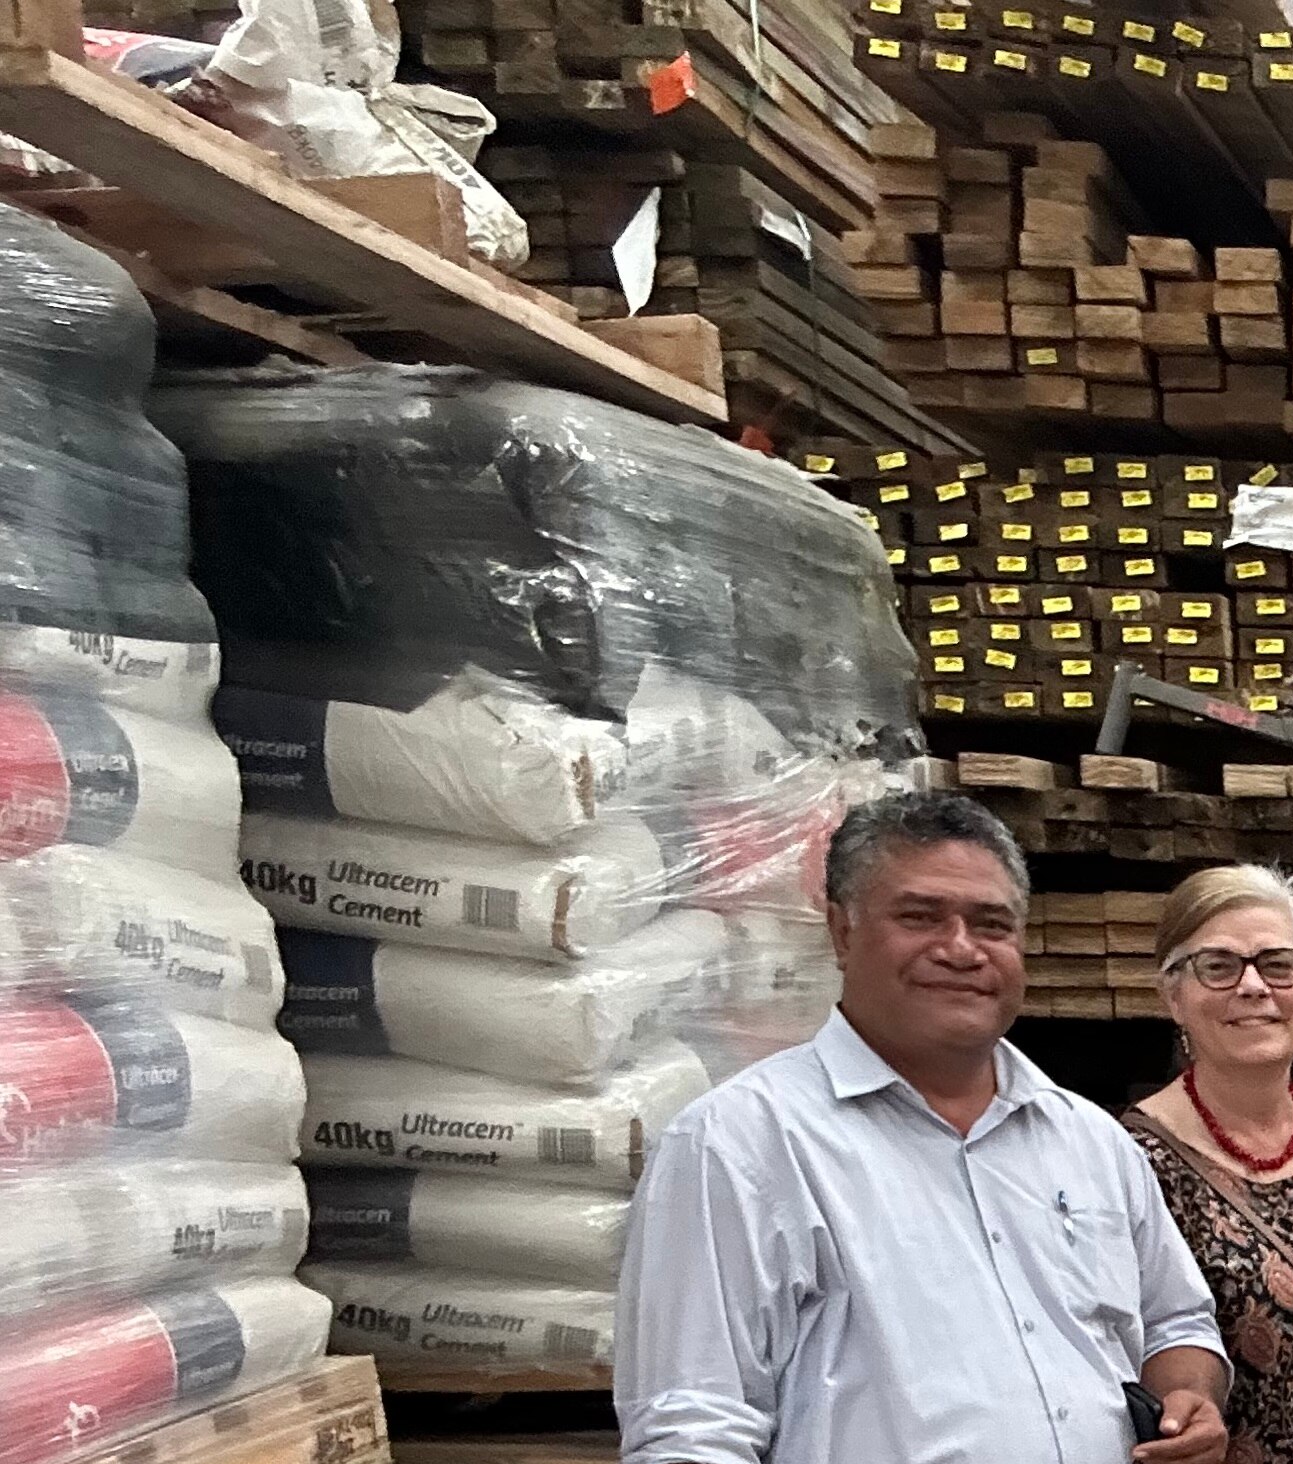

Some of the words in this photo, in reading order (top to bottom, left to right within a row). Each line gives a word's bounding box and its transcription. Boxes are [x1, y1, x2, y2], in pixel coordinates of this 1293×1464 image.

[239, 858, 317, 905] 40kg
[326, 860, 441, 897] Ultracem
[328, 893, 423, 928] Cement
[314, 1120, 396, 1157] 40kg
[401, 1112, 514, 1142] Ultracem
[405, 1144, 500, 1167] Cement
[337, 1304, 411, 1342] 40kg
